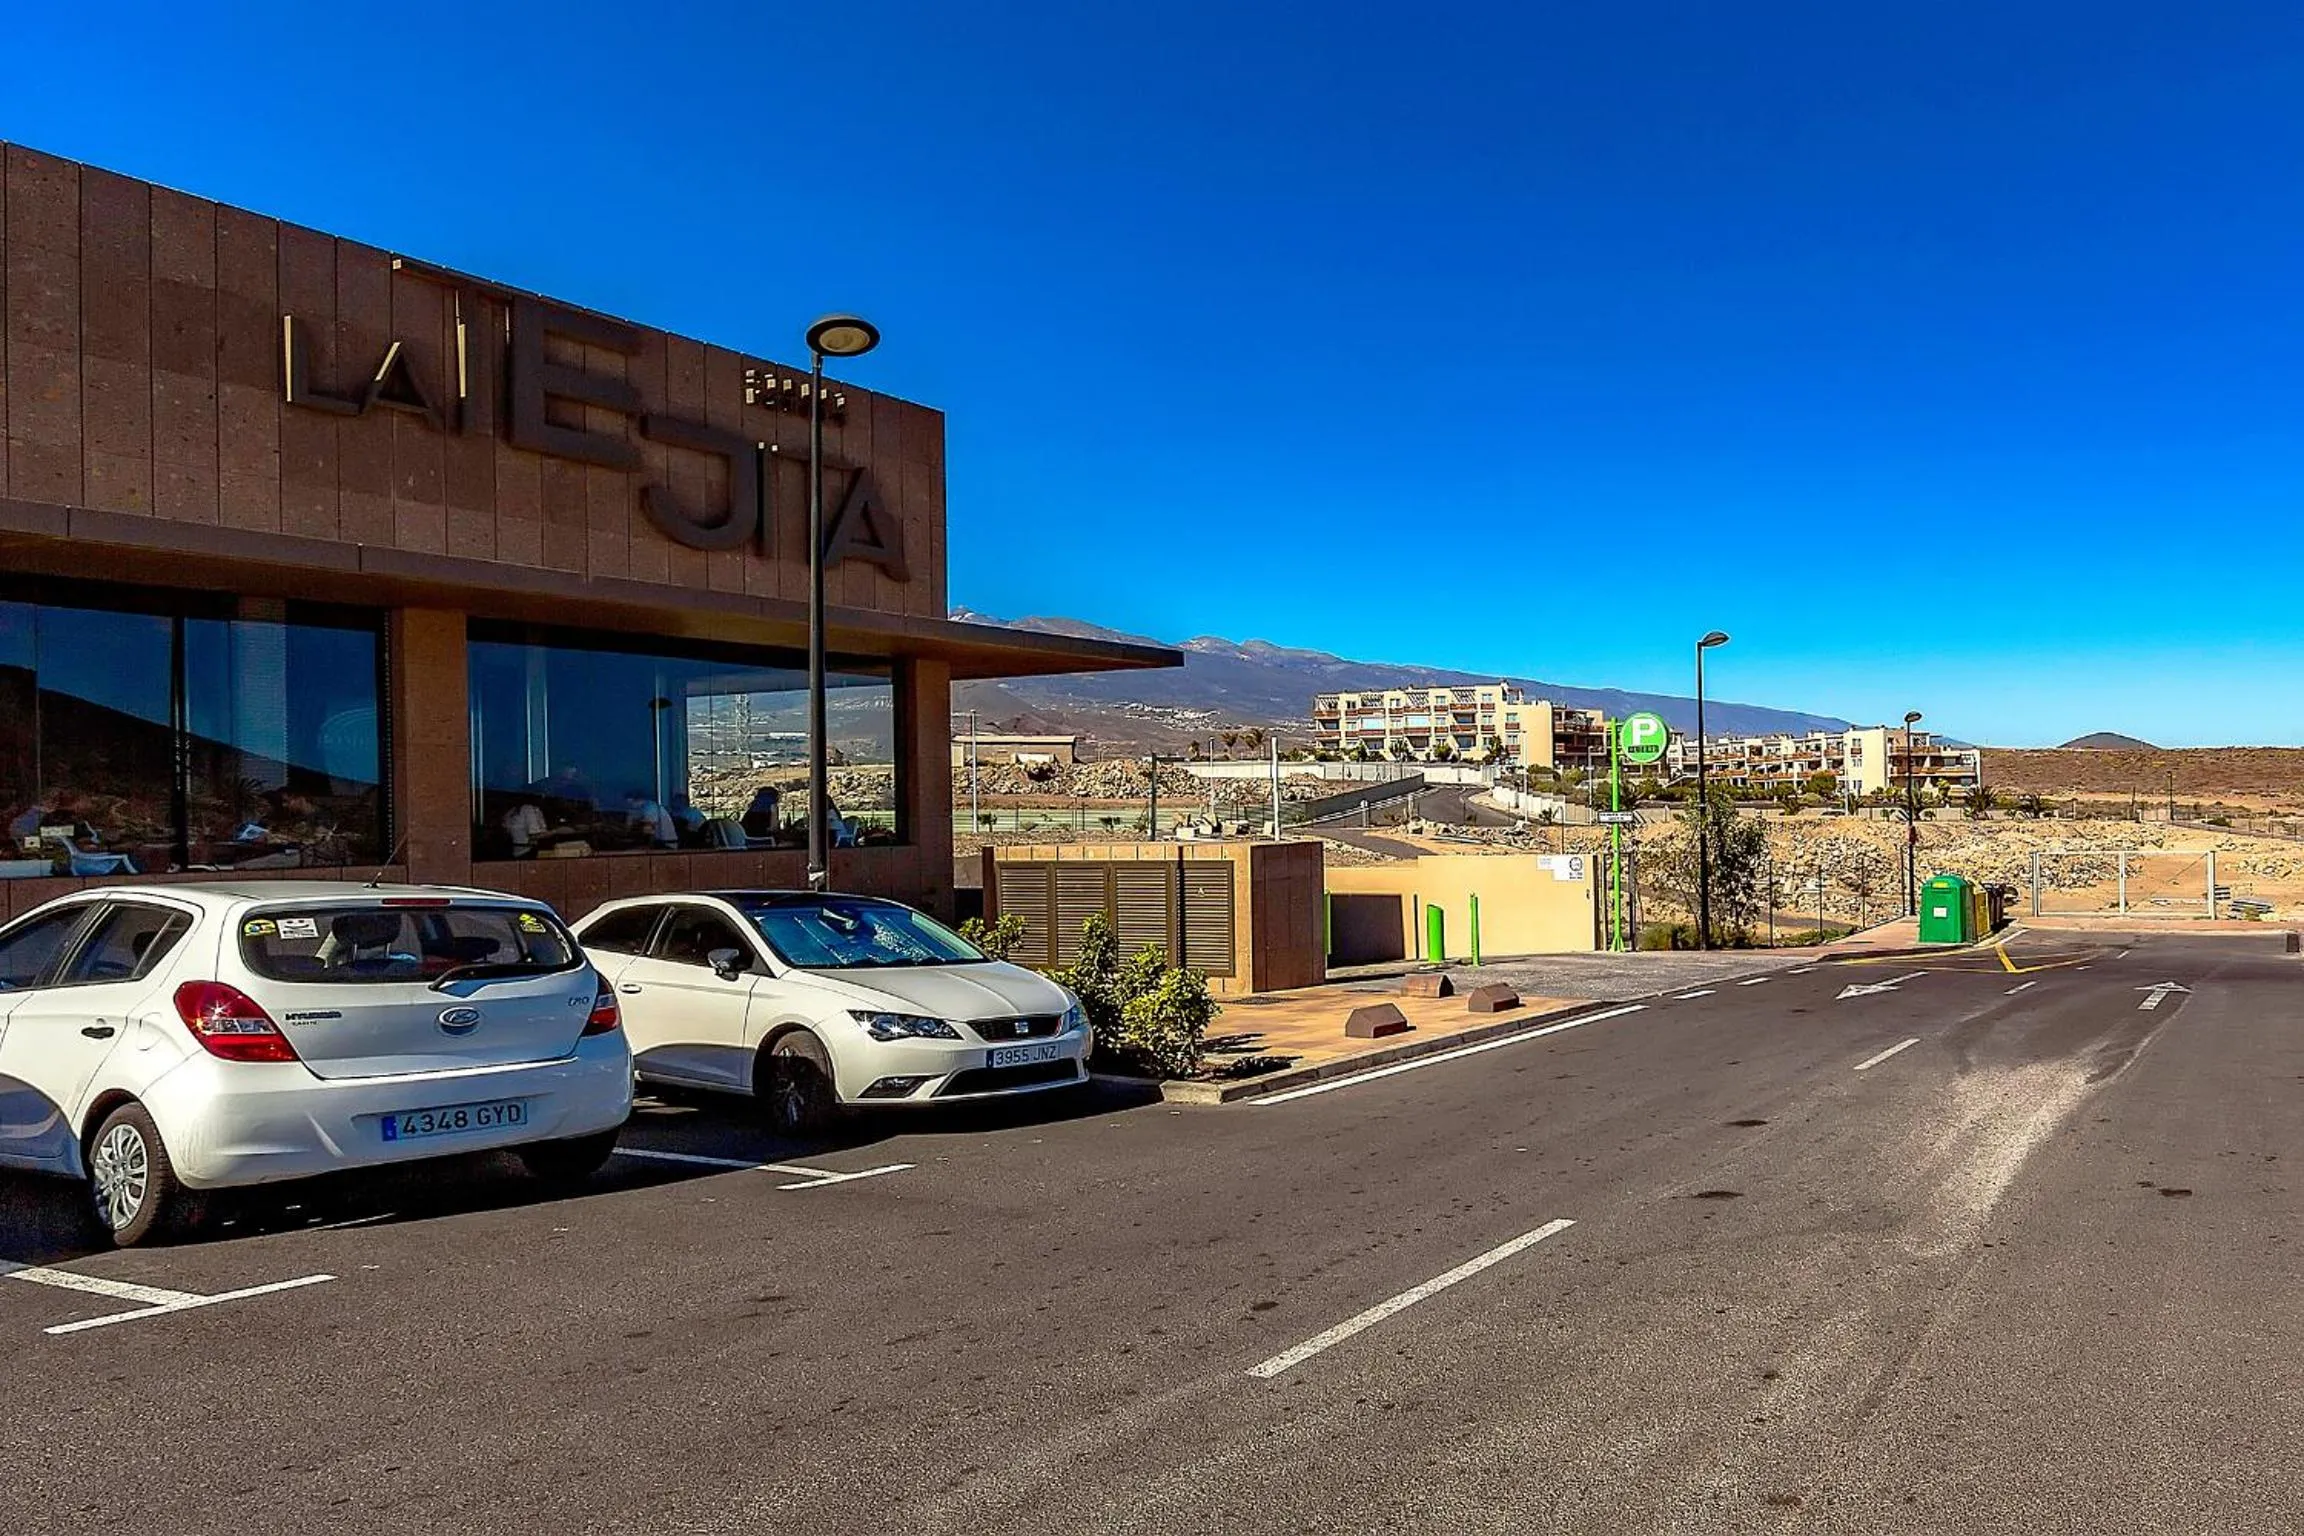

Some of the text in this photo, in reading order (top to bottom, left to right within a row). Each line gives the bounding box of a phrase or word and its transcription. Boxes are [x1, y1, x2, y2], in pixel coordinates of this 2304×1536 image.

[282, 312, 447, 436] LA
[1632, 718, 1658, 746] P
[996, 1045, 1057, 1065] 3955 JNZ
[402, 1103, 522, 1135] 4348 GYD
